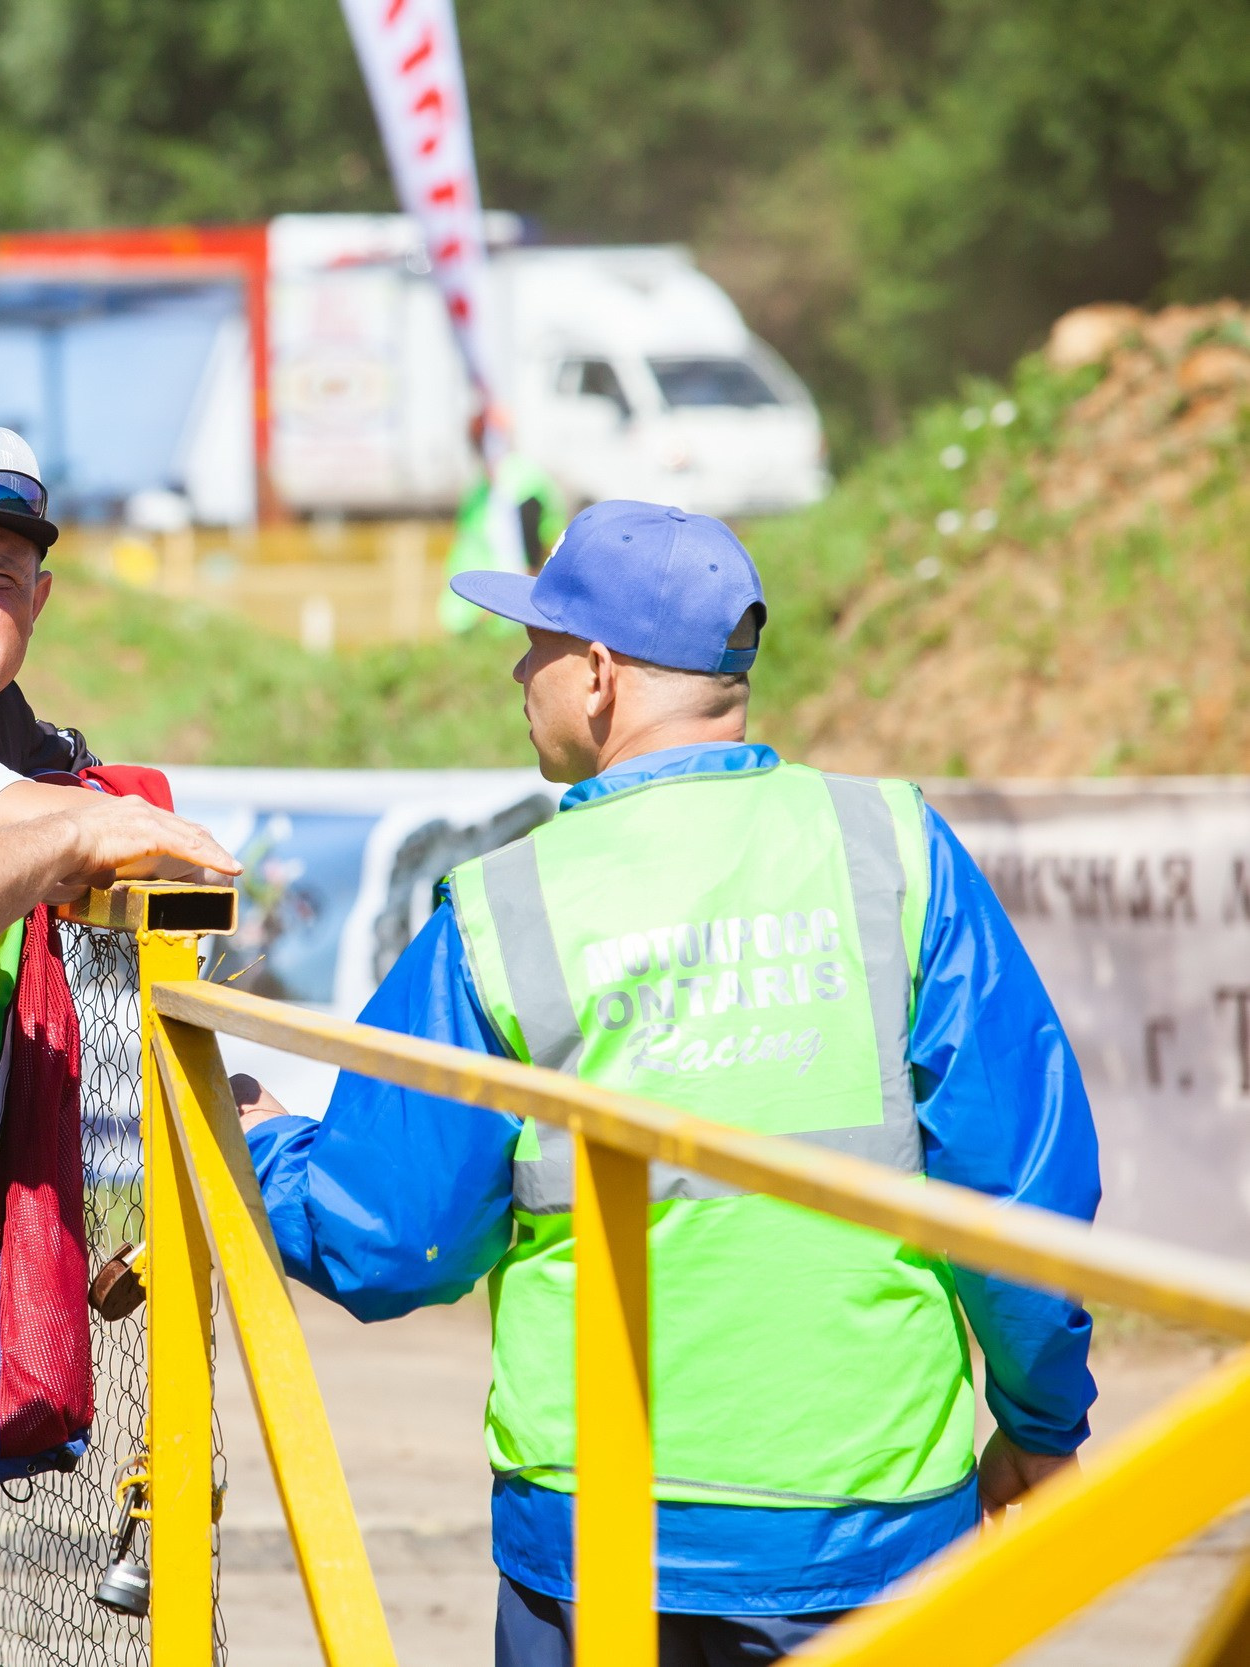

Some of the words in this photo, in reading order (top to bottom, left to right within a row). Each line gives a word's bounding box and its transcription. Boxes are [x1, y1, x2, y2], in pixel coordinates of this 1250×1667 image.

[584, 908, 840, 988] МОТОКРОСС
[597, 961, 848, 1031] ONTARIS
[627, 1022, 827, 1081] Racing
